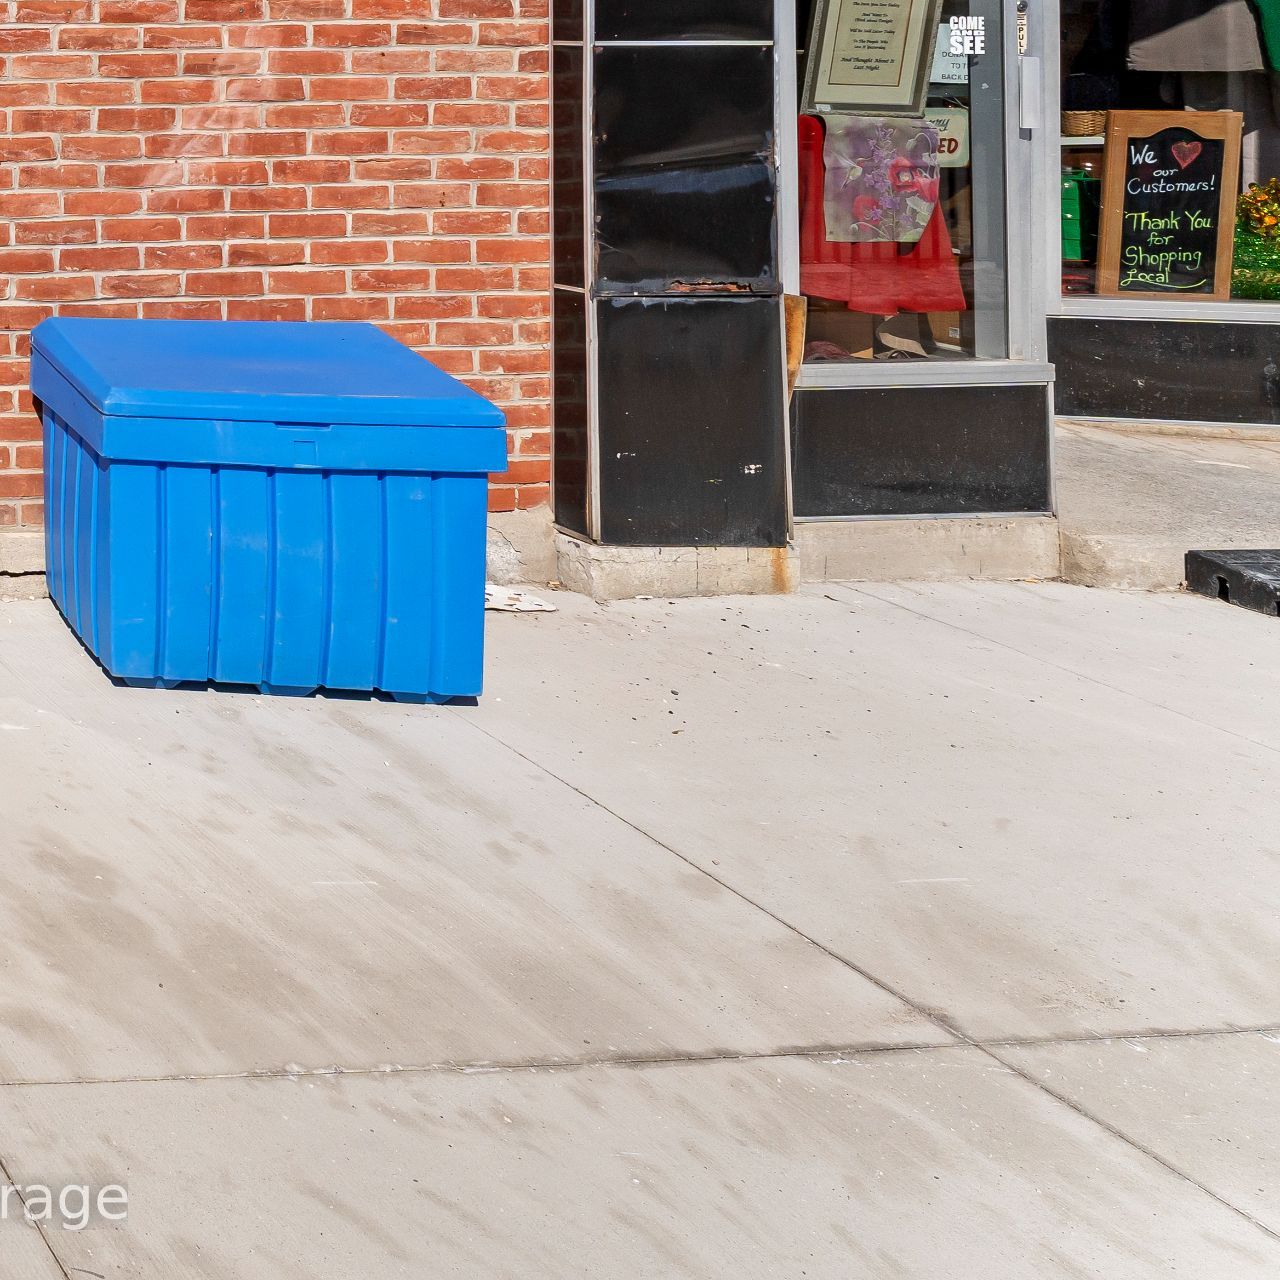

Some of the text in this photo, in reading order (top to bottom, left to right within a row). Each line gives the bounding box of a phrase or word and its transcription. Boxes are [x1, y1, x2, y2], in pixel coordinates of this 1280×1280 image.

[949, 15, 986, 30] COME
[949, 35, 986, 55] SEE
[941, 73, 964, 81] BACK
[1130, 144, 1158, 165] We
[1152, 168, 1179, 177] our
[1127, 174, 1216, 195] Customers!
[1125, 209, 1211, 232] Thank You
[1146, 231, 1175, 247] for
[1121, 245, 1202, 273] Shopping
[1120, 266, 1170, 287] Local
